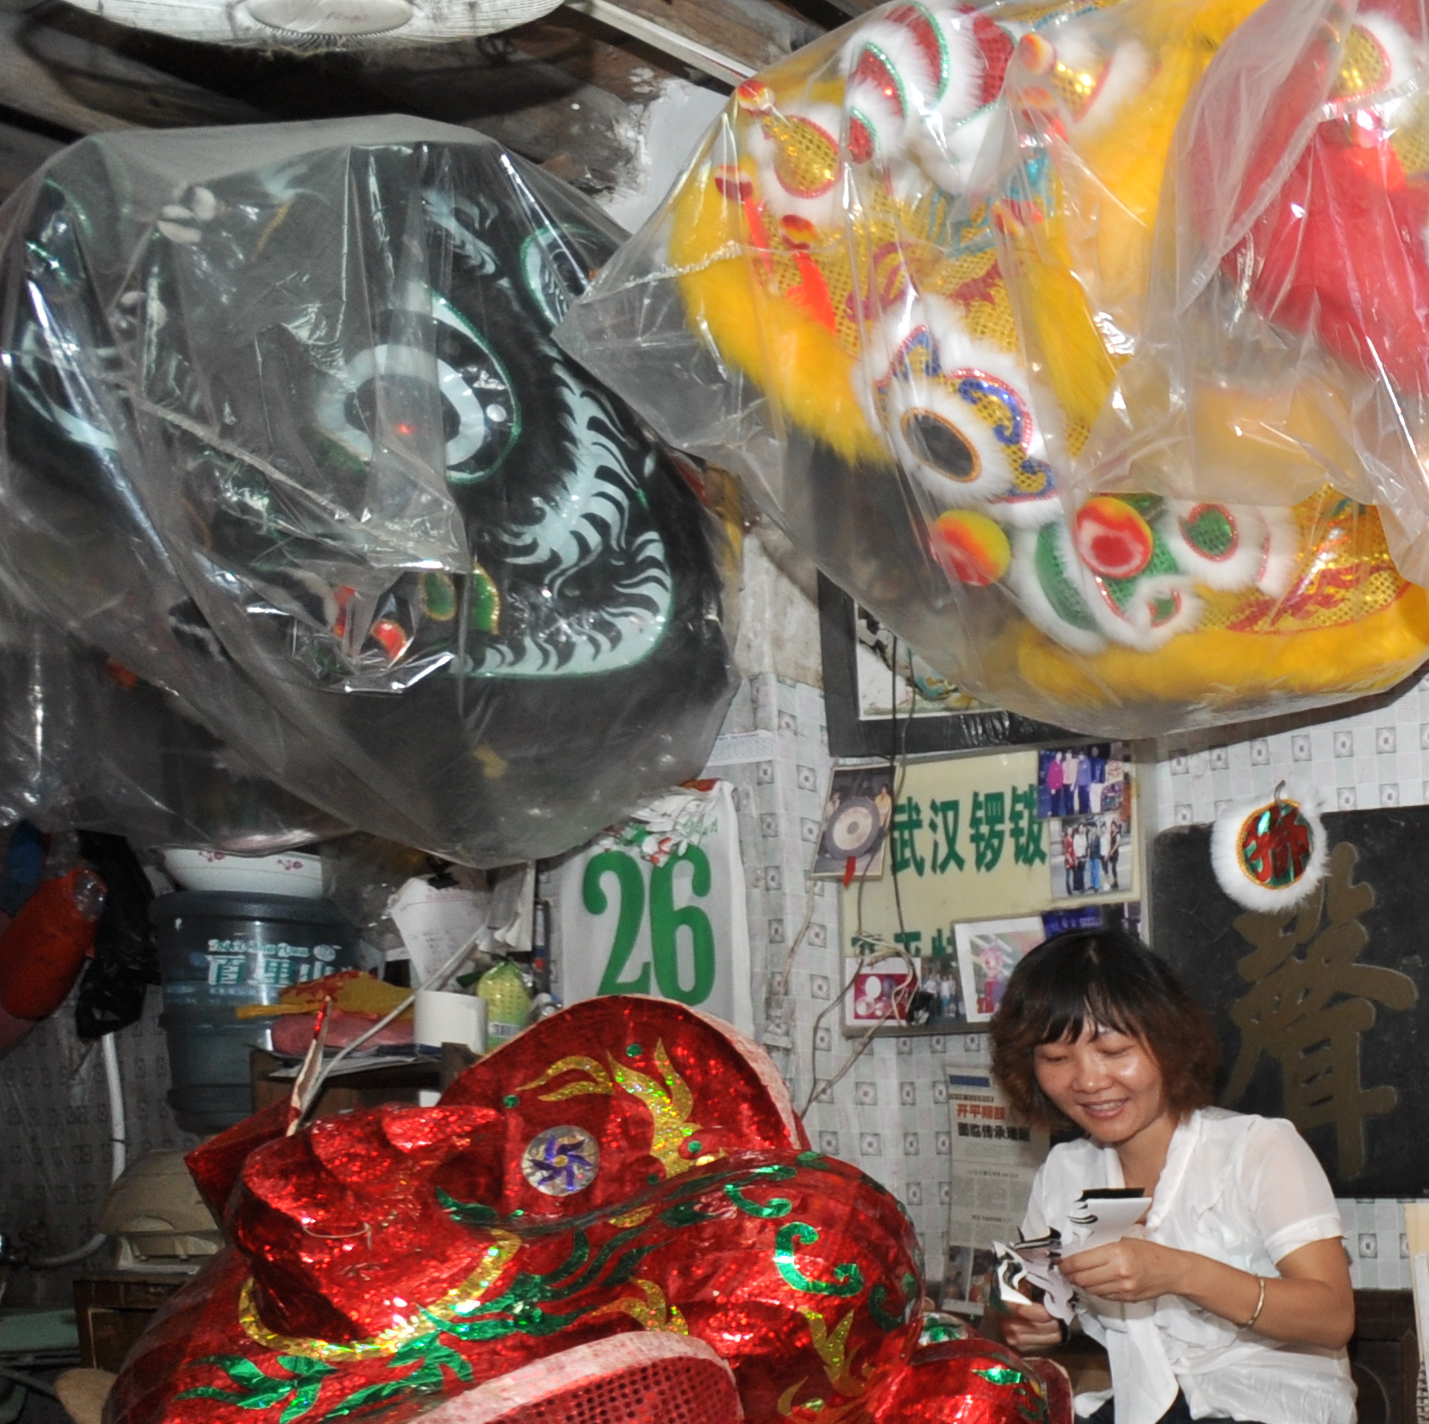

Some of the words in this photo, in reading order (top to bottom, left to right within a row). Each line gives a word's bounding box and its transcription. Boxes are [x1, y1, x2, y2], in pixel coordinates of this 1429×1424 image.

[892, 784, 1047, 878] 武汉锣钹
[583, 844, 716, 1006] 26
